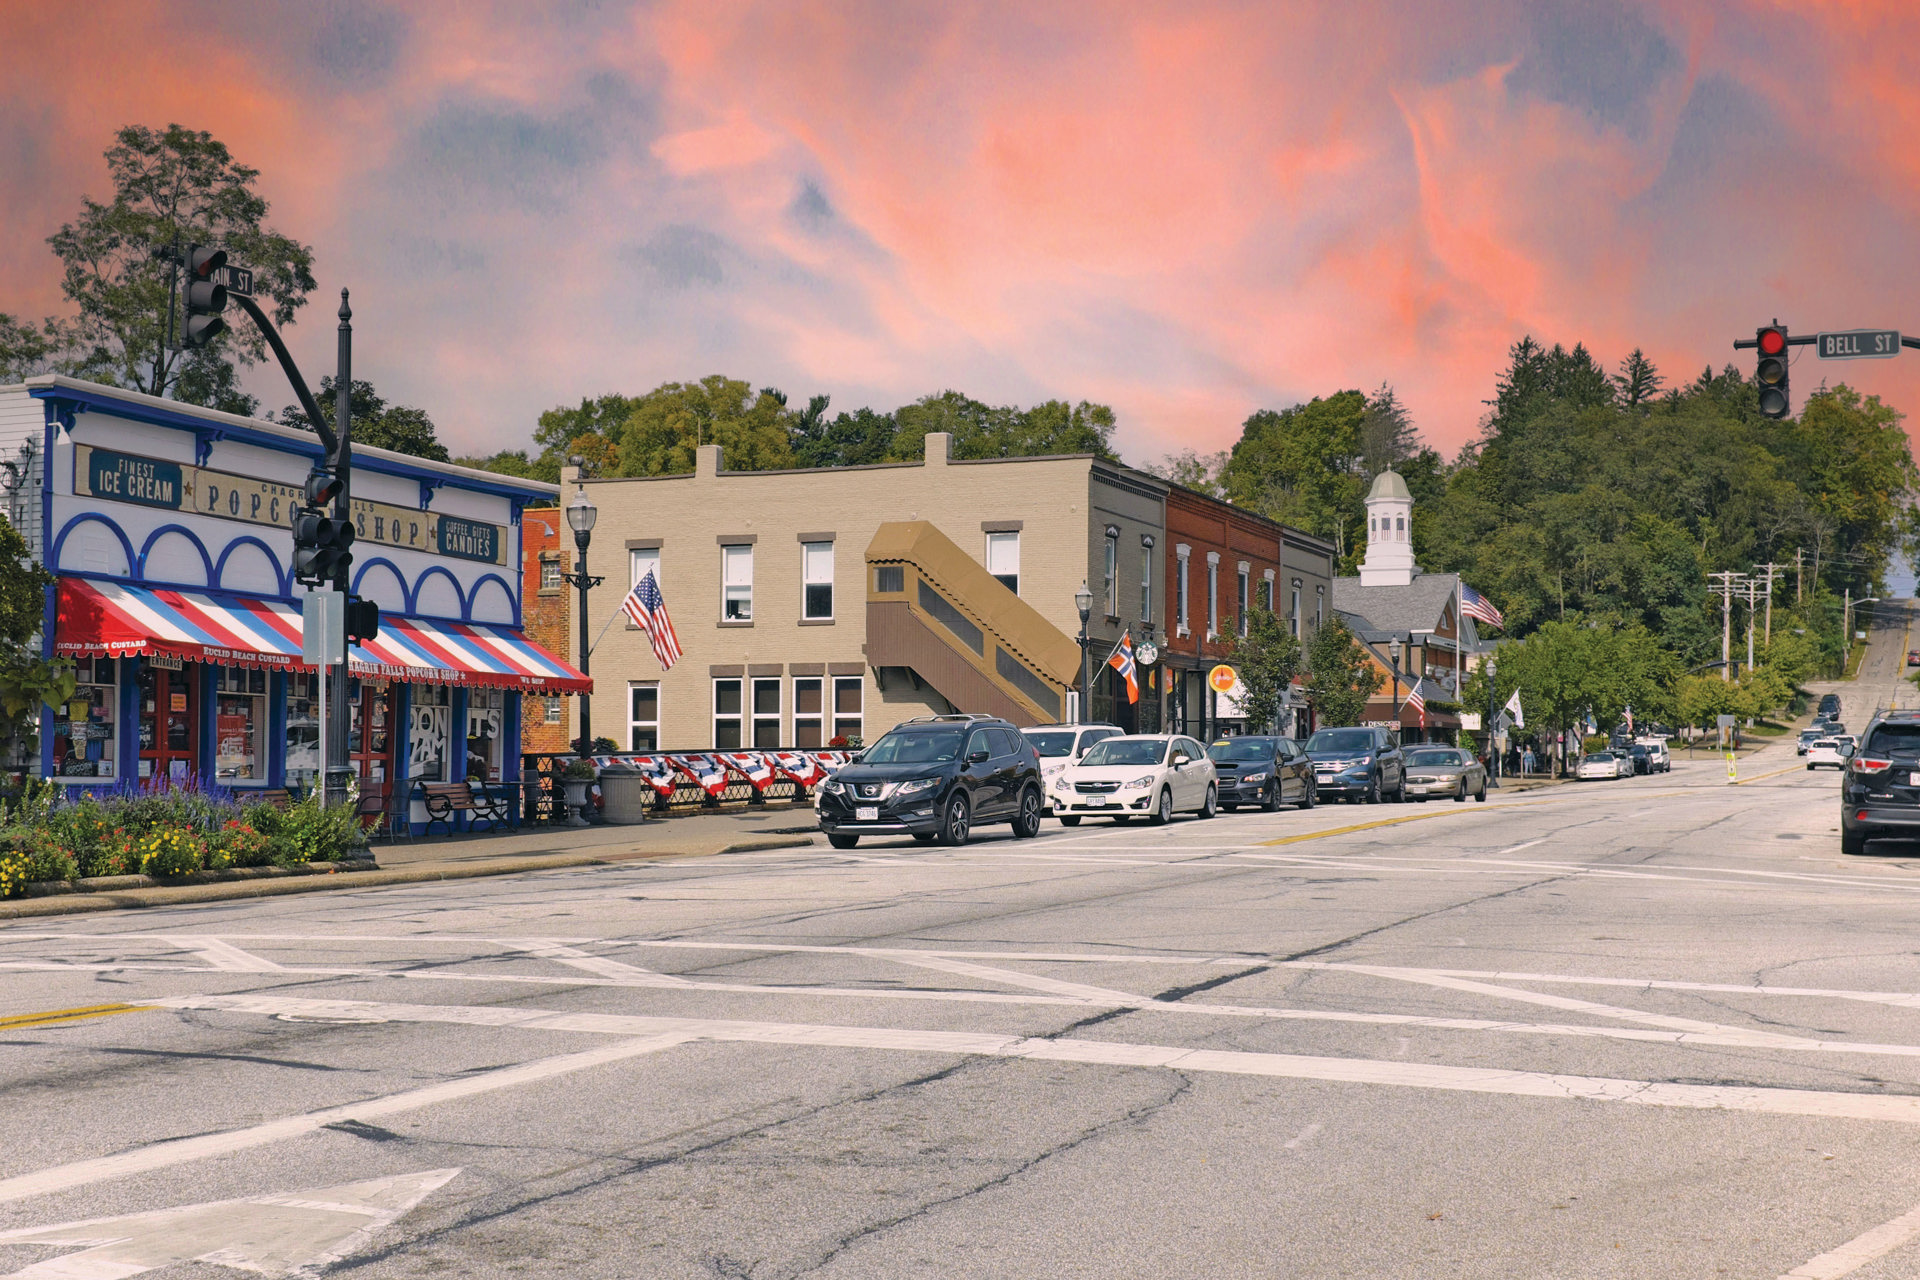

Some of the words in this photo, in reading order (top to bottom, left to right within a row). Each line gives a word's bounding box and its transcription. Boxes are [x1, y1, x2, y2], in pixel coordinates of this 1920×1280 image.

[211, 266, 230, 288] AIN
[238, 271, 249, 291] ST
[1826, 335, 1861, 355] BELL
[1875, 334, 1892, 352] ST
[119, 459, 154, 478] FINEST
[100, 470, 121, 493] ICE
[128, 475, 173, 503] CREAM
[261, 483, 304, 500] CHAGR
[354, 501, 375, 513] LLS
[357, 512, 419, 546] SHOP
[446, 520, 468, 536] COFFEE
[472, 525, 490, 540] GIFTS
[446, 532, 490, 557] CANDIES
[84, 642, 109, 650] BEACH
[111, 639, 147, 649] CUSTARD
[203, 646, 230, 658] EUCLID
[232, 650, 256, 661] BEACH
[258, 653, 290, 664] CUSTARD
[348, 660, 379, 674] HAGRIN
[380, 664, 405, 677] FALLS
[406, 666, 439, 680] POPCORN
[440, 668, 459, 680] SHOP
